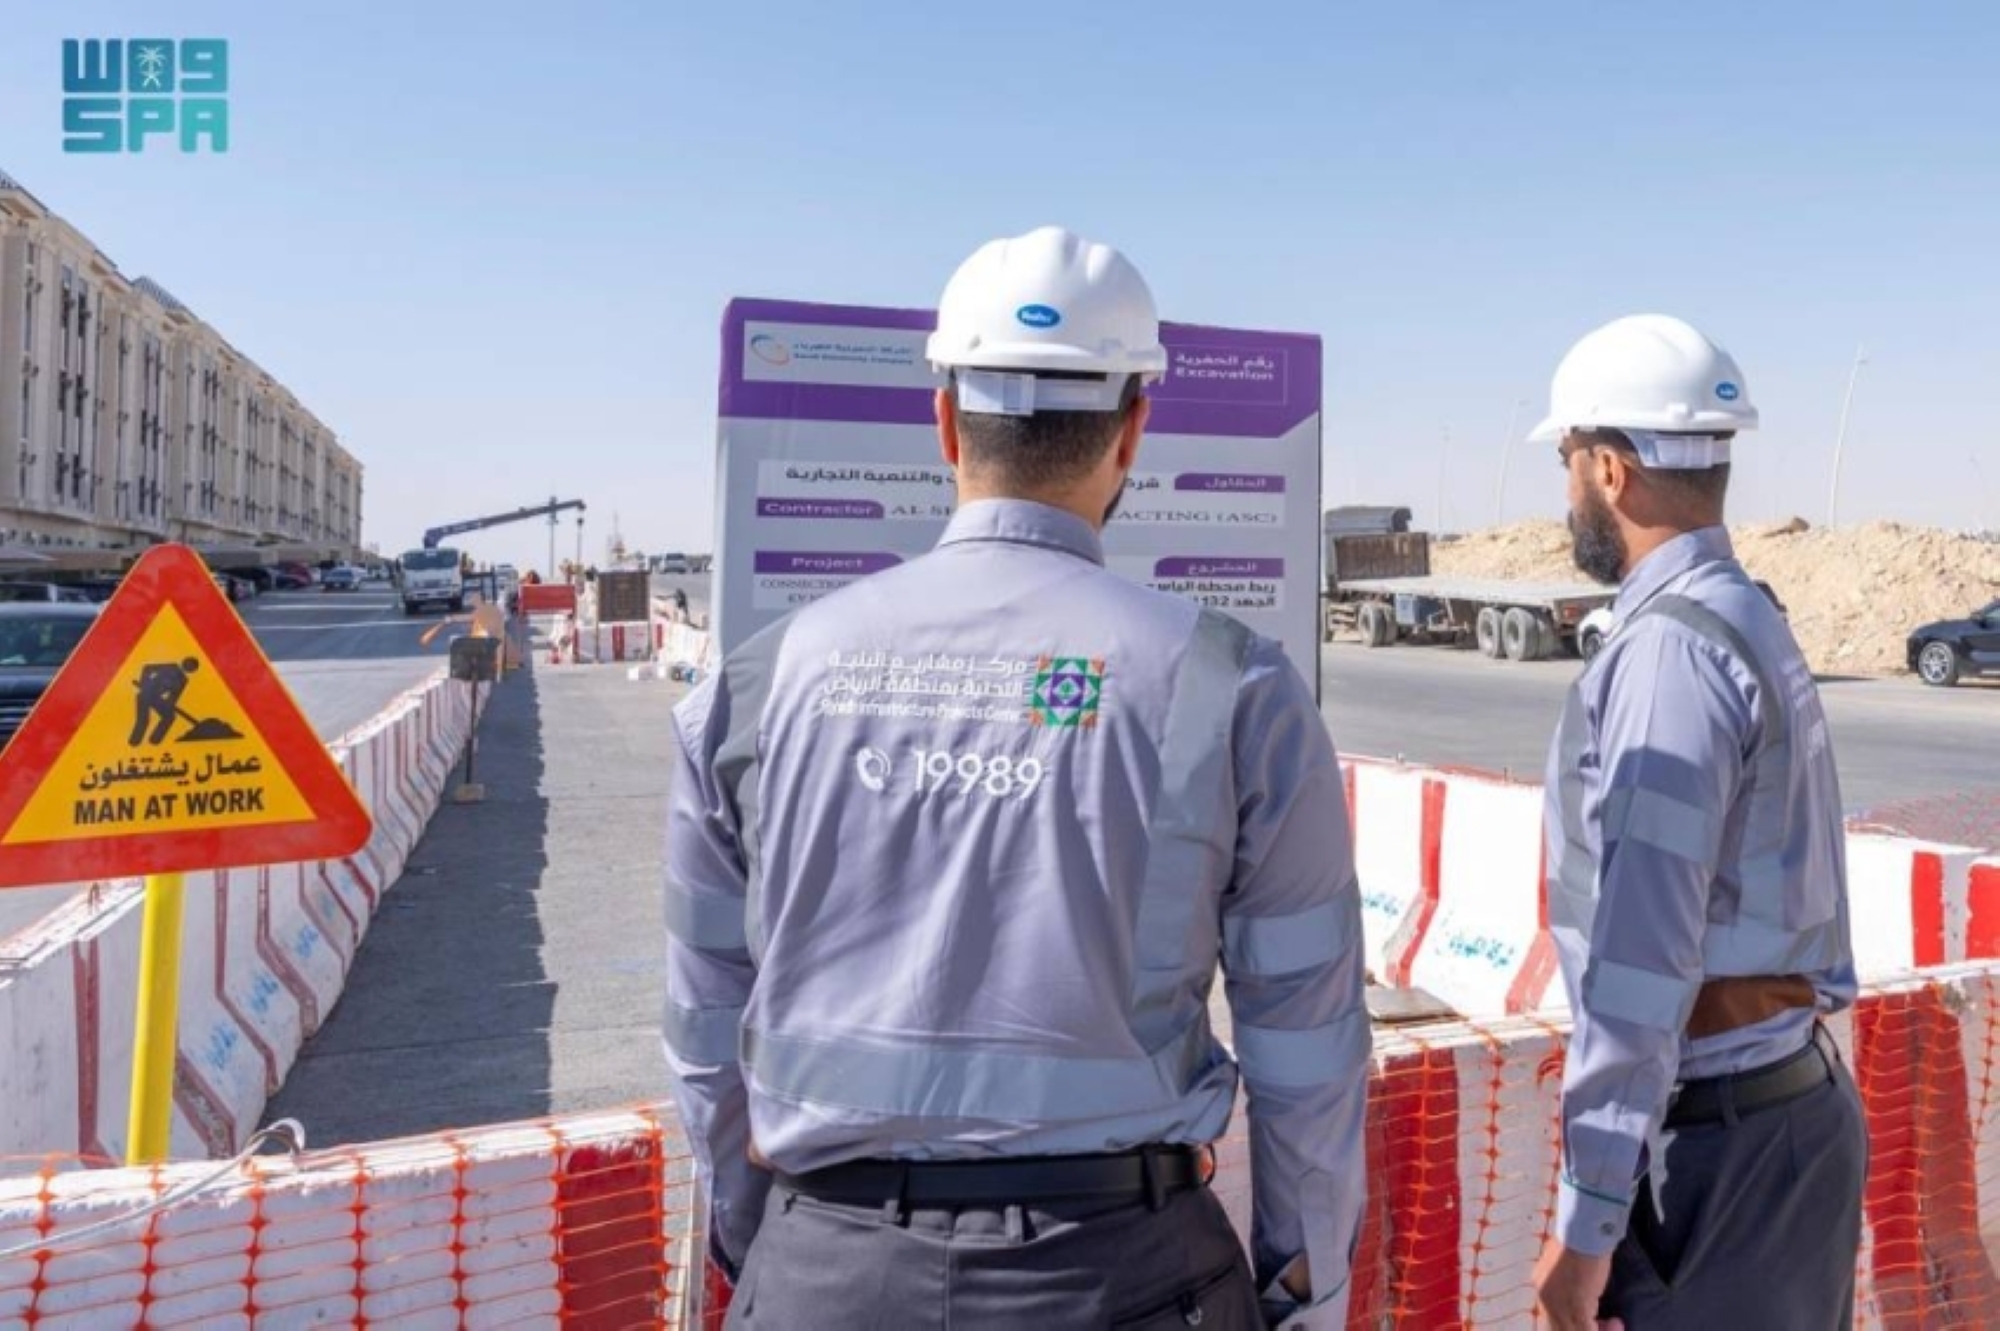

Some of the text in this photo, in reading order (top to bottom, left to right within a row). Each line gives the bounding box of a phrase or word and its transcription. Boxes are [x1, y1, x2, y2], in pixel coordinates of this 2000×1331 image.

[1174, 366, 1275, 381] Excavation
[764, 502, 873, 516] Contractor
[1216, 510, 1277, 524] (ASC)
[791, 557, 863, 569] Project
[1188, 561, 1258, 576] المشروع
[79, 752, 262, 792] عمال يشتغلون
[913, 749, 1042, 801] 19989
[73, 787, 265, 826] MAN AT WORK
